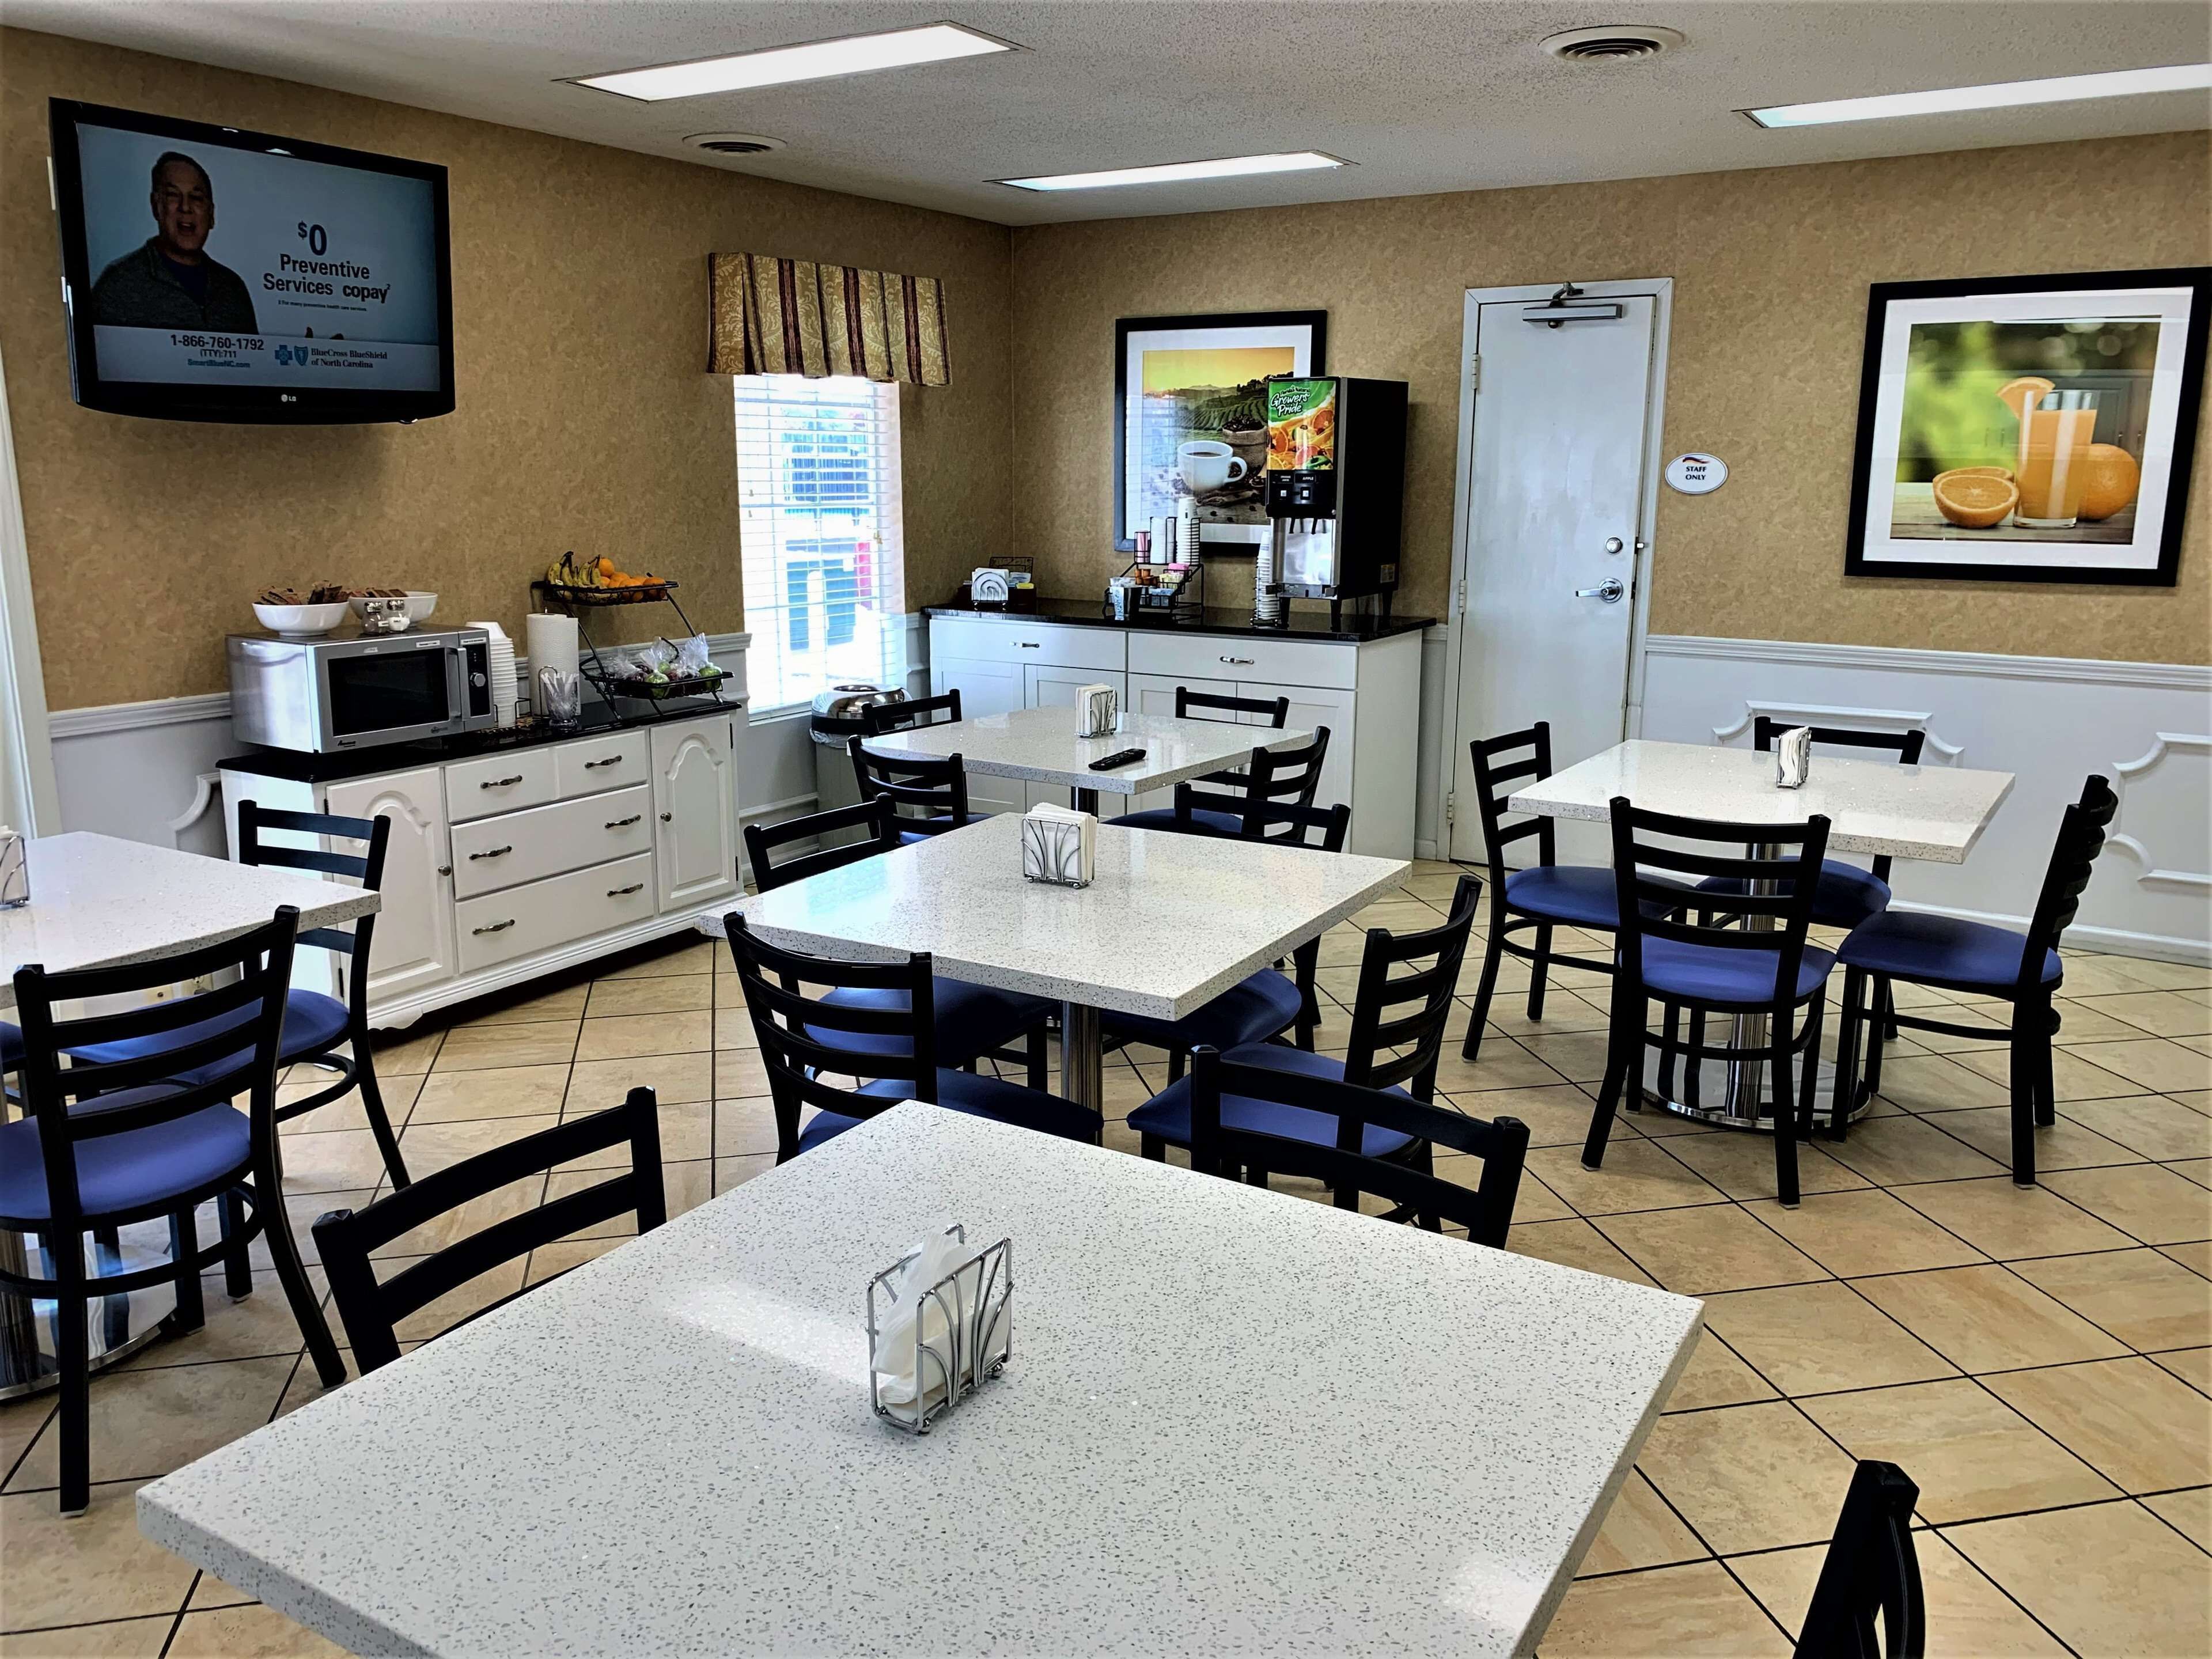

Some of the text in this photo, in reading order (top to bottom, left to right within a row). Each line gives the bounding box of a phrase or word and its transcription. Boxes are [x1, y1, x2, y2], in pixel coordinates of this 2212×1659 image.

[297, 221, 327, 256] $0
[280, 253, 370, 279] Preventive
[263, 273, 333, 295] Services
[171, 335, 264, 351] 1-866-760-1792
[311, 348, 388, 359] BlueCross BlueShield
[320, 359, 341, 367] North
[342, 359, 373, 369] Carolina
[1277, 402, 1302, 416] Pride
